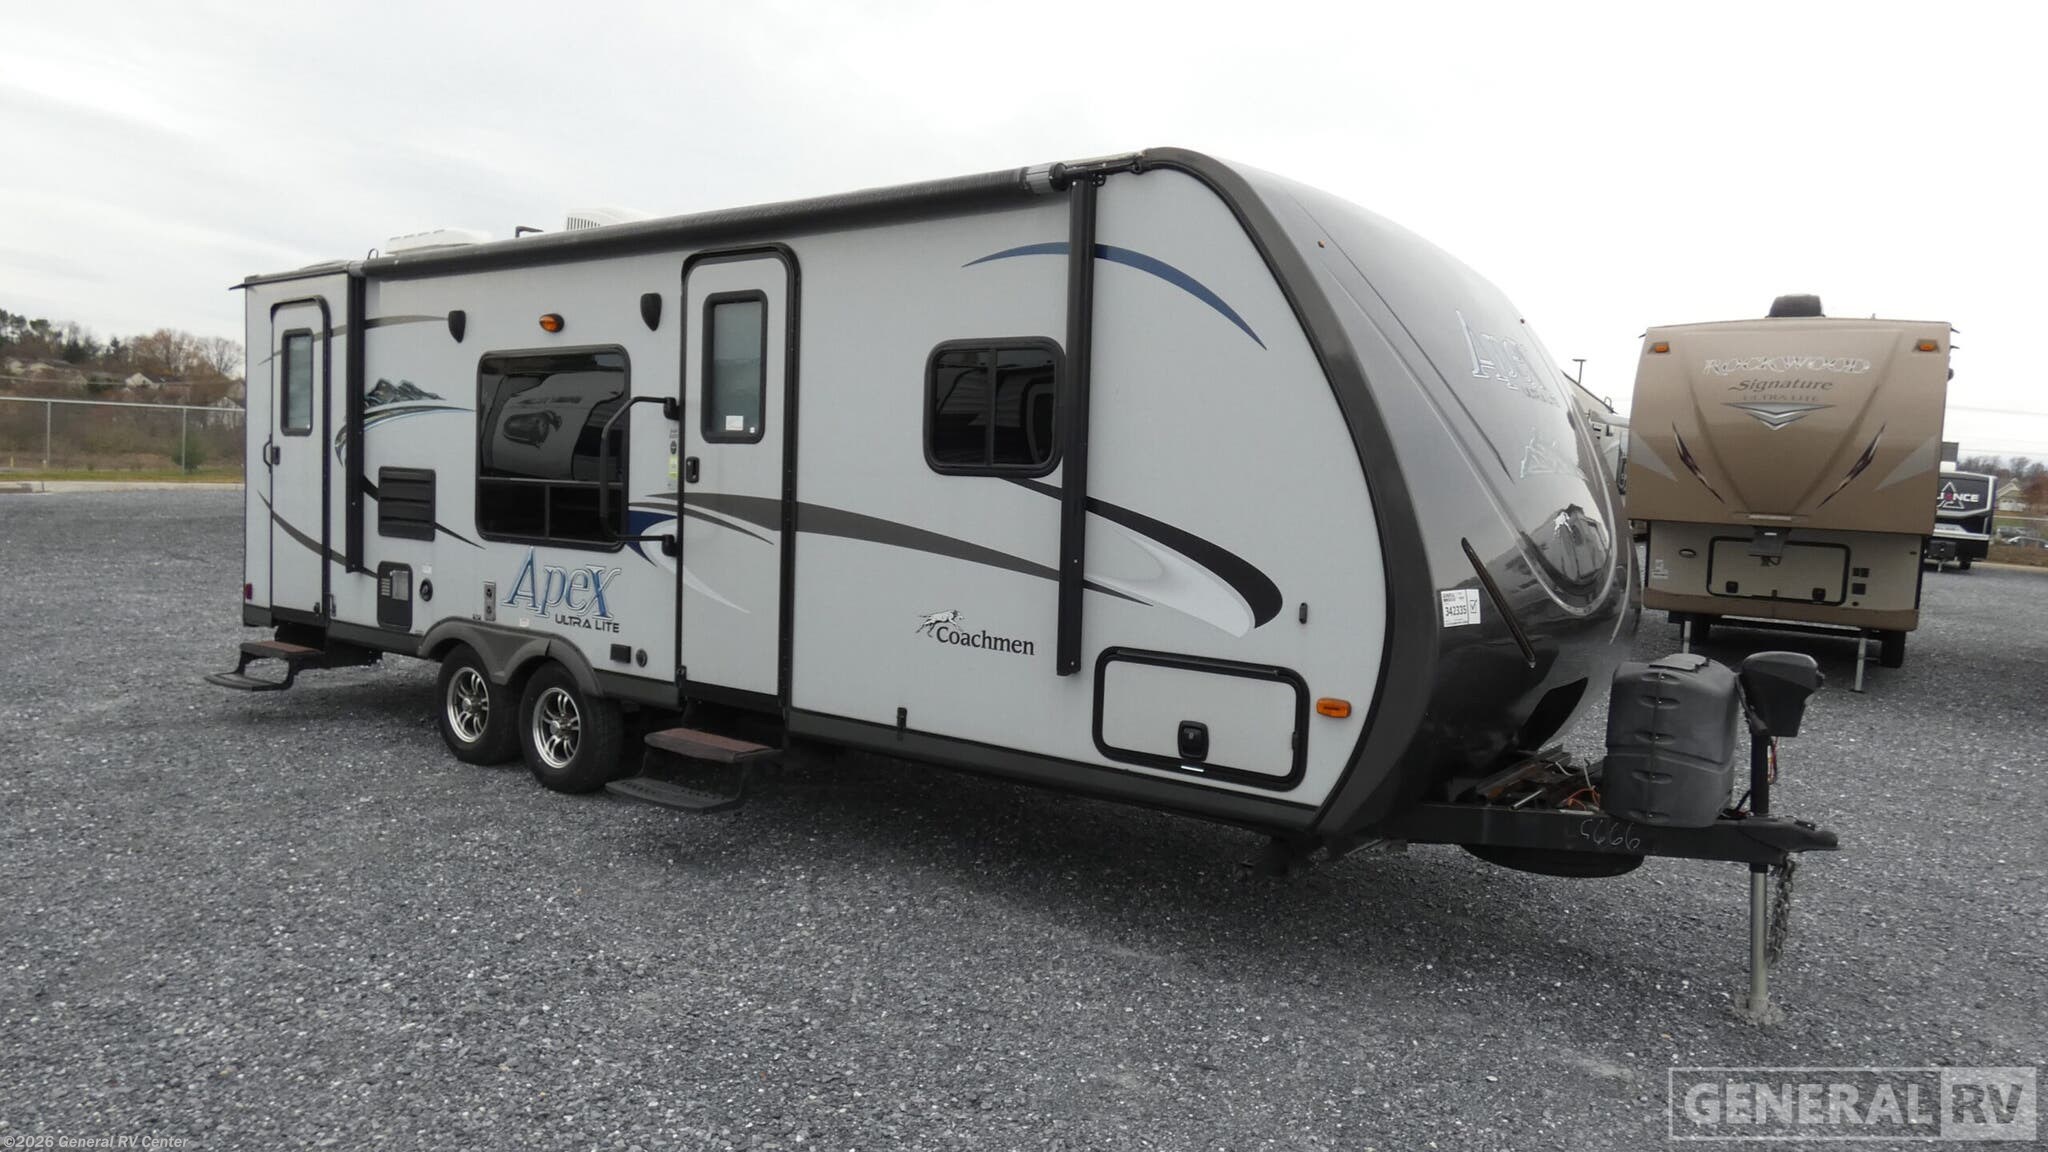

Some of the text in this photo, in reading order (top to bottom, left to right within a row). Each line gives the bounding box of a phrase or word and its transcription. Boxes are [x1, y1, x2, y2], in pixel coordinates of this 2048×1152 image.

[1703, 355, 1872, 377] ROCKWOOD
[1728, 378, 1833, 392] Signature
[555, 613, 620, 633] ULTRA LITE
[936, 626, 1035, 656] Coachmen
